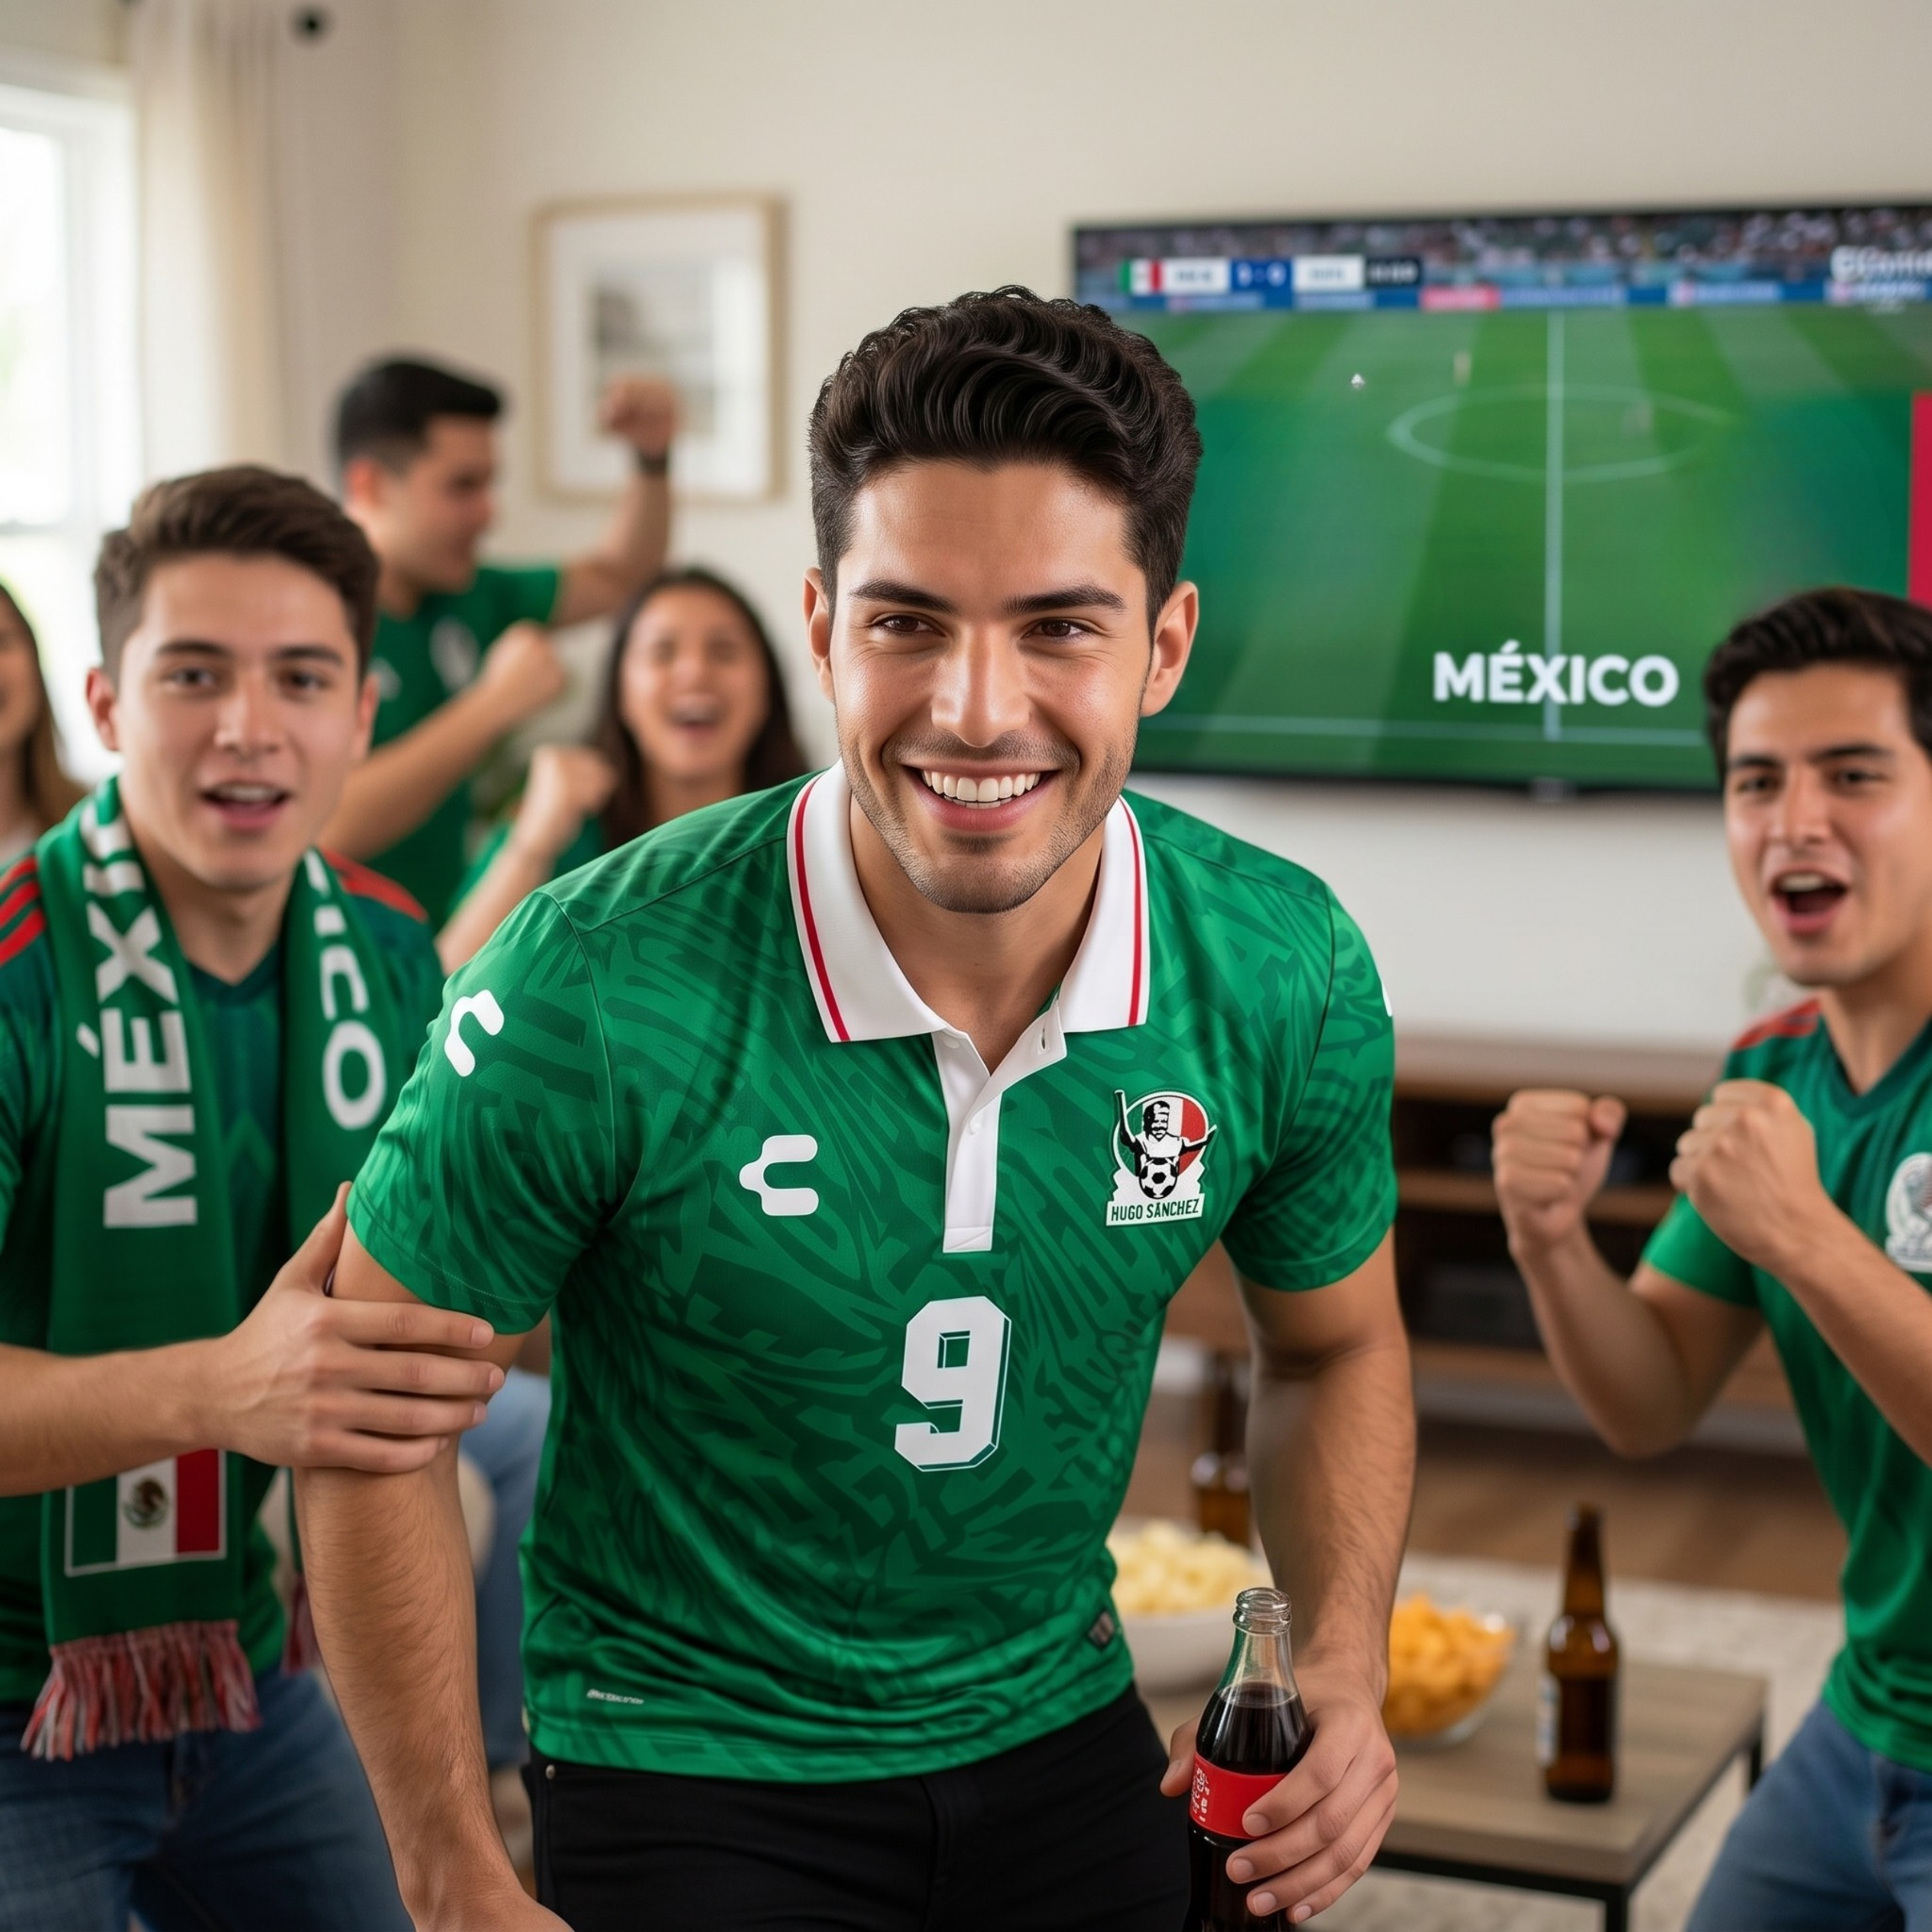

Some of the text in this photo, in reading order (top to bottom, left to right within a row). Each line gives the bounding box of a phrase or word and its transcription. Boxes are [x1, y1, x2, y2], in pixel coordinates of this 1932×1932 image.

[1433, 639, 1679, 707] MÉXICO
[1111, 1198, 1199, 1221] HUGO SÁNCHEZ
[894, 1296, 1012, 1472] 9
